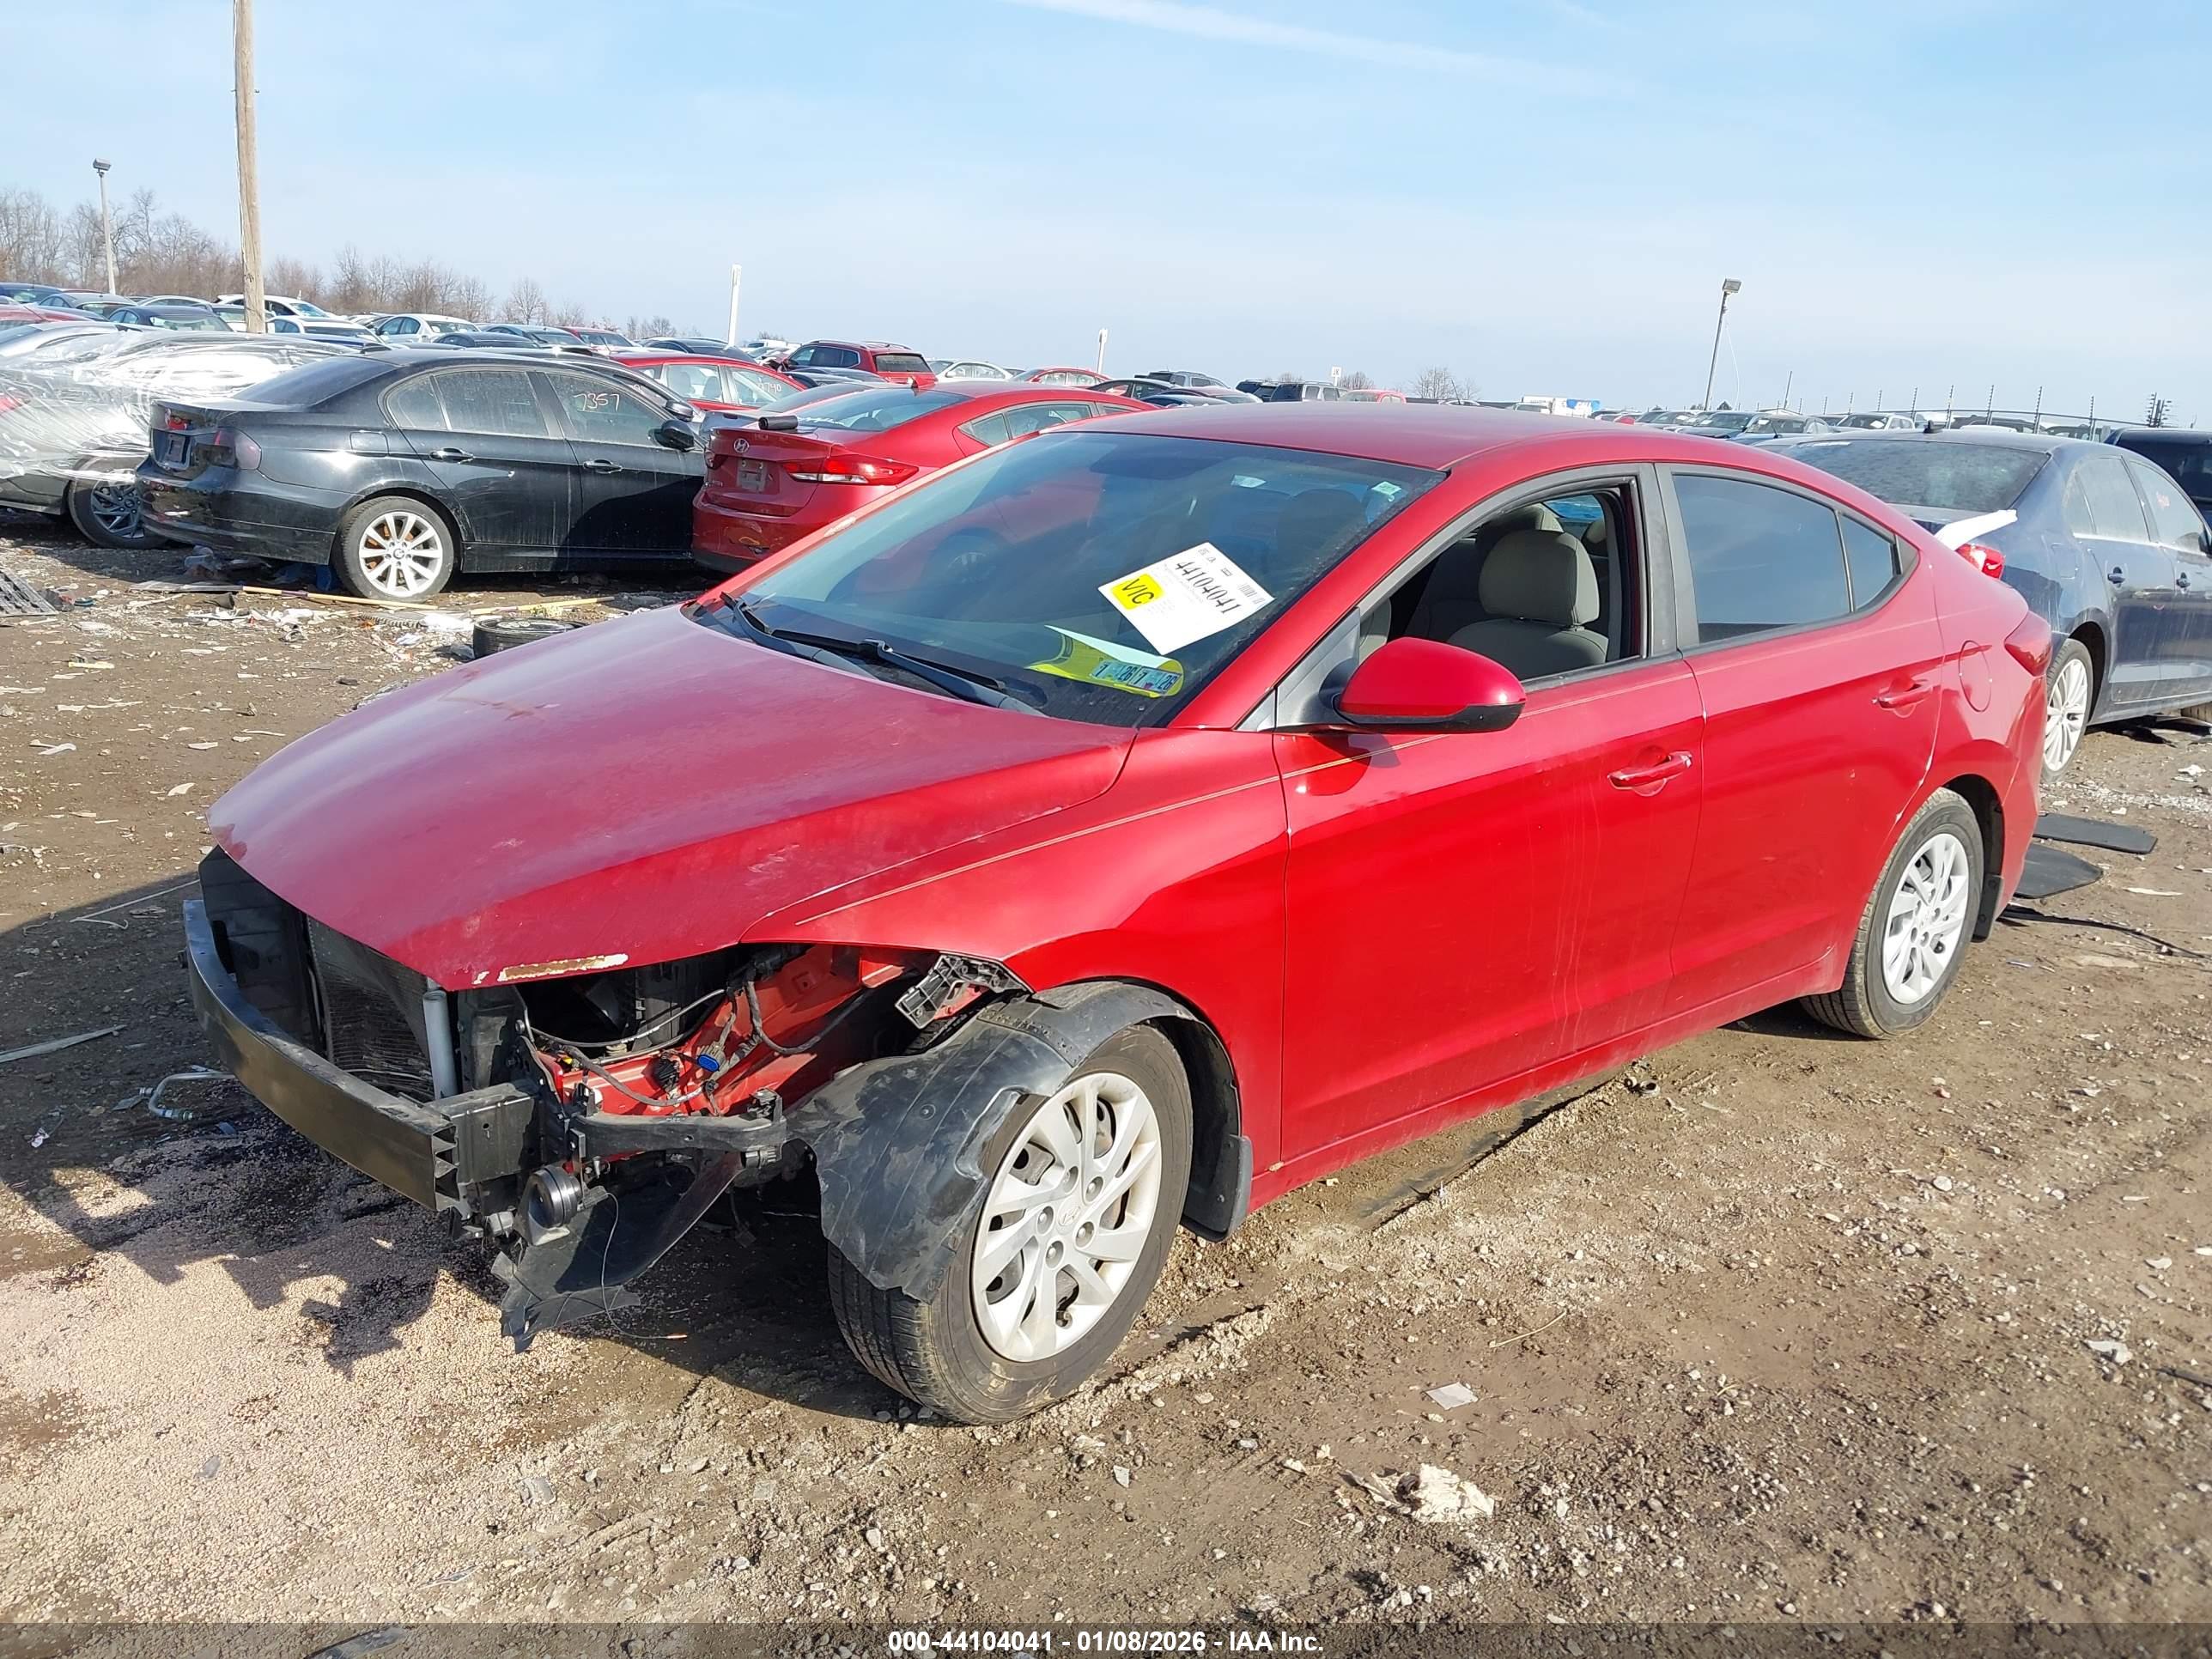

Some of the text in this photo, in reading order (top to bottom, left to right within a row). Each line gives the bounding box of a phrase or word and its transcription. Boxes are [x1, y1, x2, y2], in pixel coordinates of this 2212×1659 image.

[573, 392, 620, 412] 7357
[1121, 578, 1155, 605] VIC
[1175, 561, 1242, 614] 44104041
